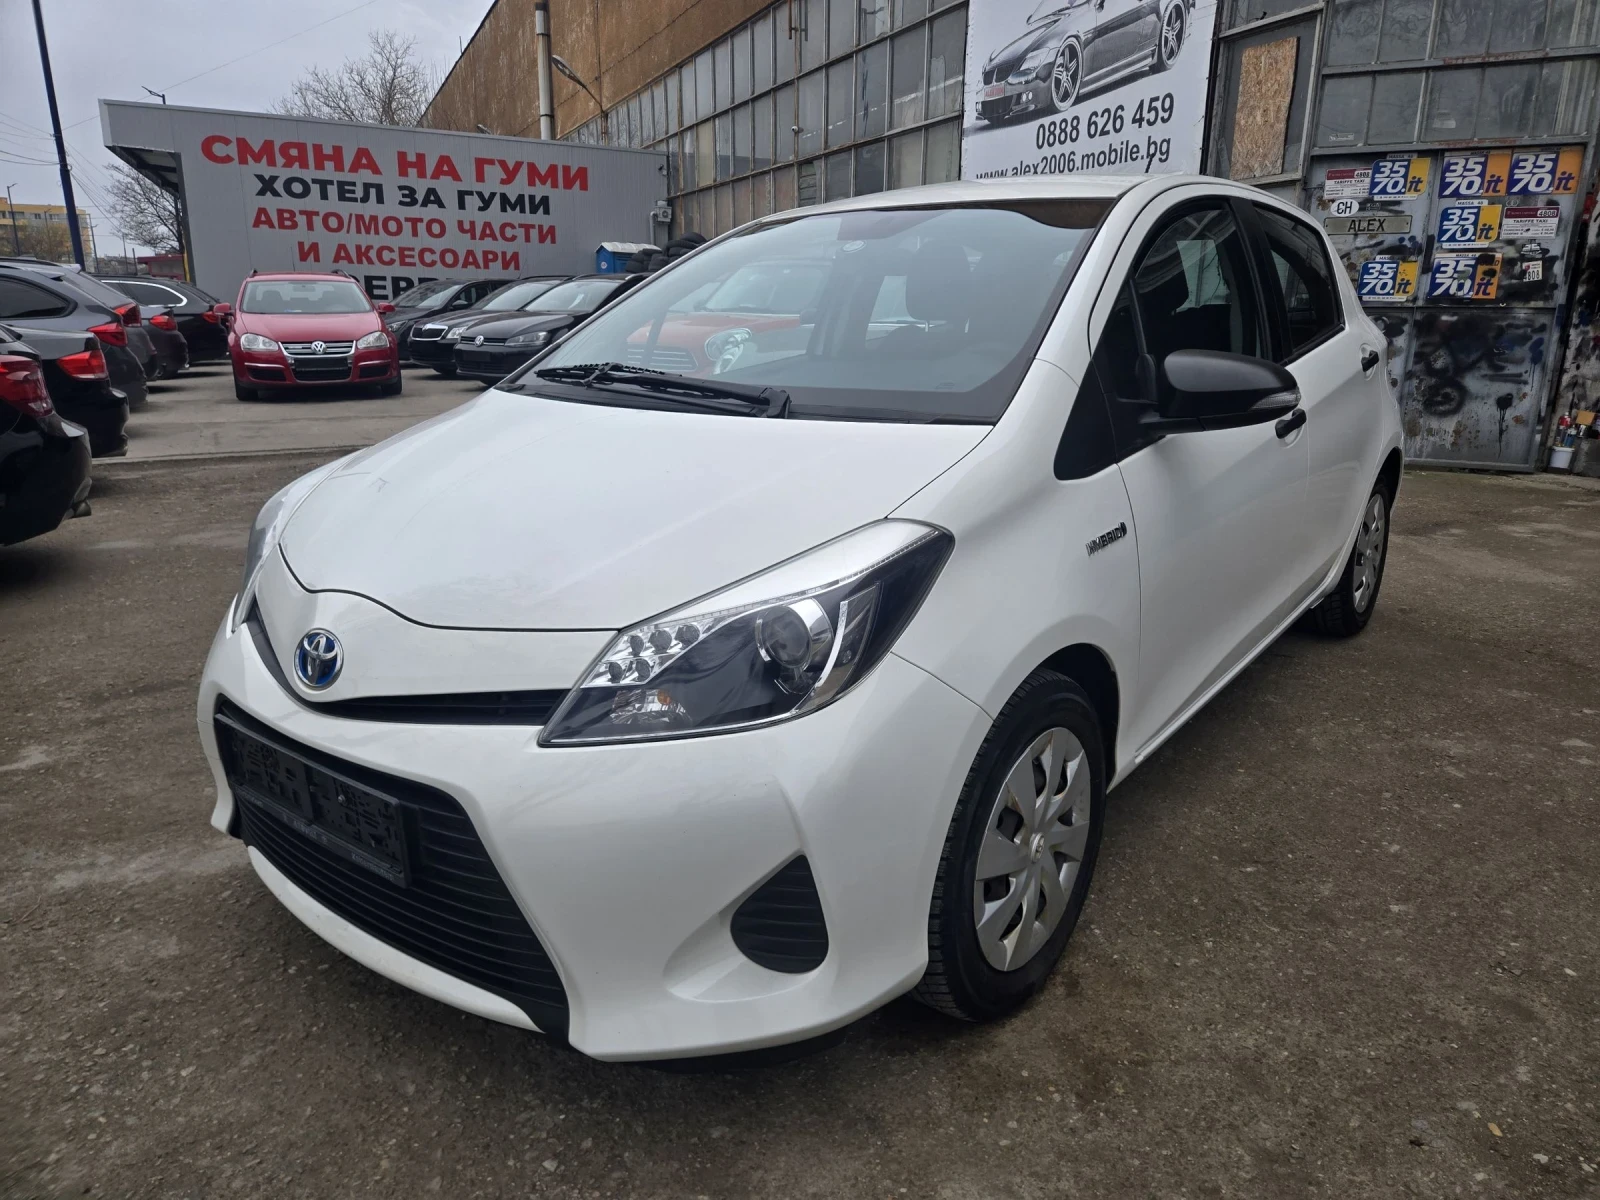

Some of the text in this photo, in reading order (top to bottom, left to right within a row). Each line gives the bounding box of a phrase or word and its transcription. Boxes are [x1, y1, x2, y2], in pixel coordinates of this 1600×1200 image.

[1036, 92, 1175, 150] 0888 626 459
[201, 134, 589, 191] СМЯНА НА ГУМИ
[1374, 161, 1409, 178] 35
[1444, 157, 1485, 177] 35
[1513, 153, 1557, 174] 35
[253, 173, 551, 216] ХОТЕЛ ЗА ГУМИ
[1336, 201, 1353, 215] CH
[1443, 208, 1478, 225] 35
[252, 206, 557, 245] АВТО/МОТО ЧАСТИ
[1347, 218, 1386, 233] ALEX
[297, 241, 520, 271] И АКСЕСОАРИ
[1362, 263, 1397, 279] 35
[1435, 260, 1476, 279] 35
